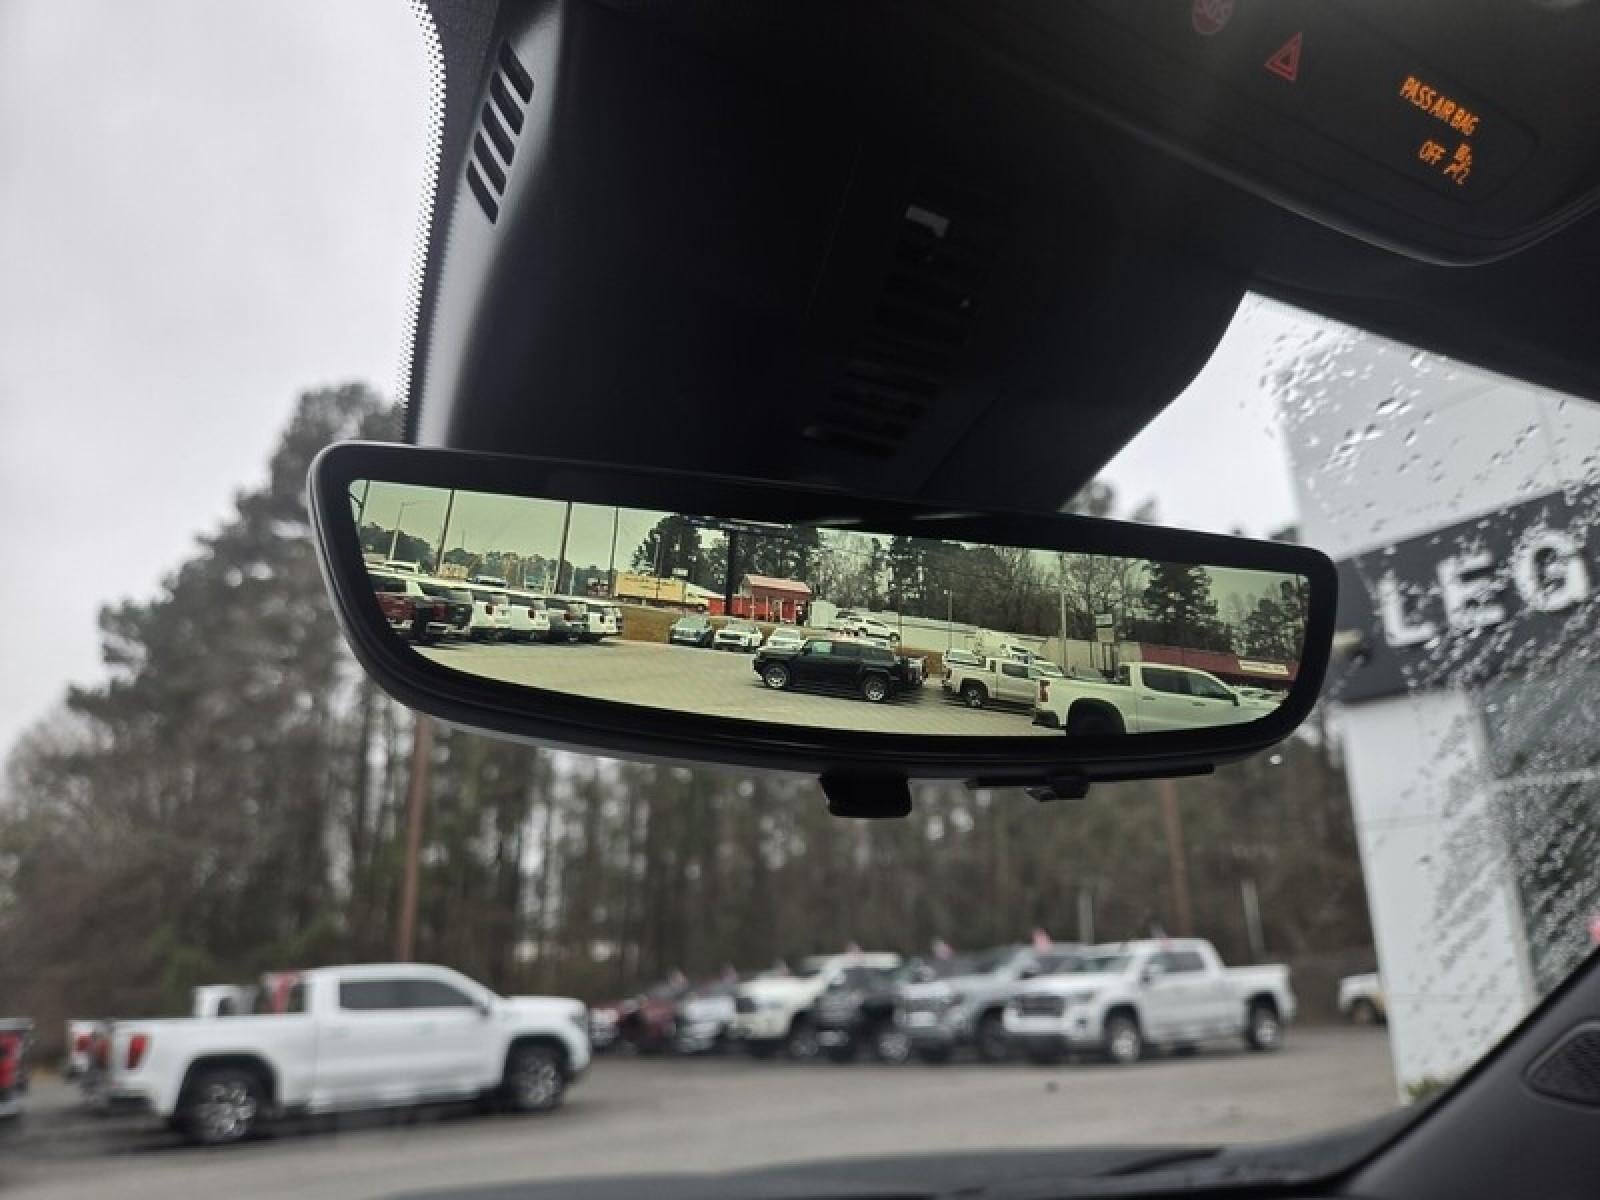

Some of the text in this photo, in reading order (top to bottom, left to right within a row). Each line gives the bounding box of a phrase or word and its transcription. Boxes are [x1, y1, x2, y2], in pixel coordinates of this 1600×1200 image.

[1400, 76, 1480, 136] PASS AIR BAG
[1419, 140, 1446, 165] OFF
[1377, 528, 1588, 646] LEG
